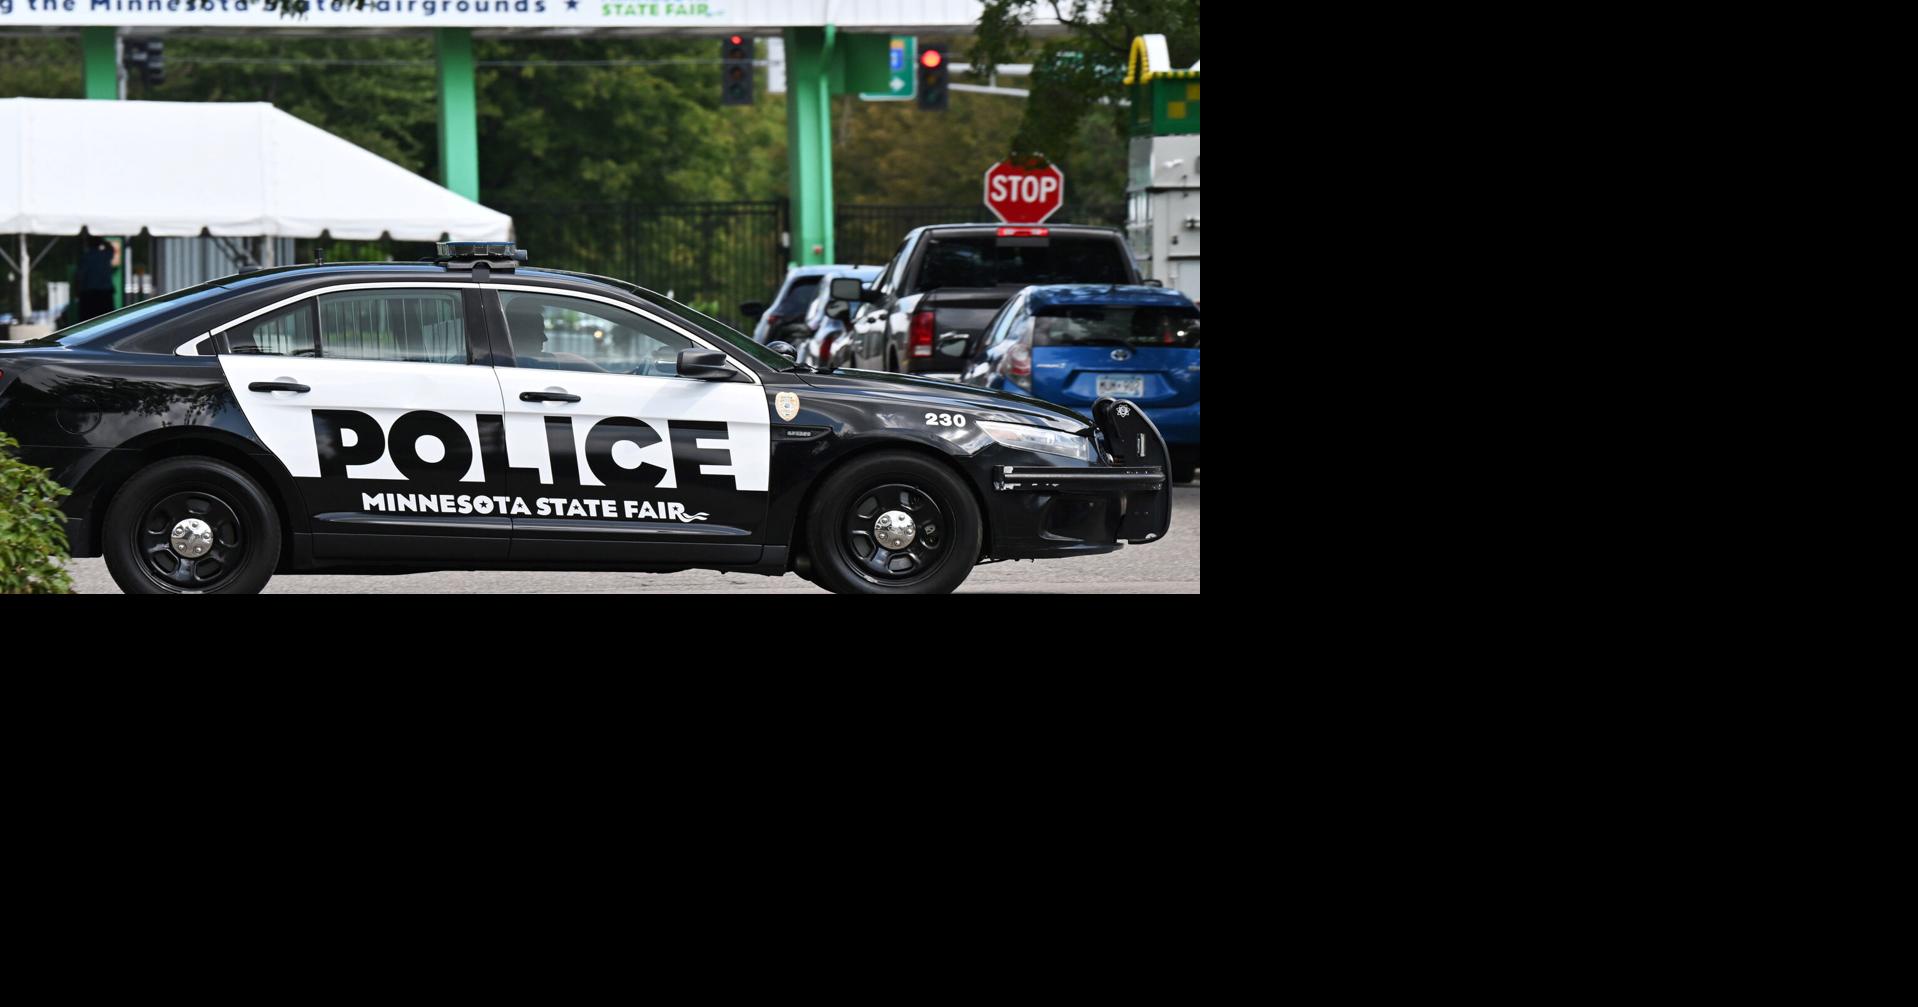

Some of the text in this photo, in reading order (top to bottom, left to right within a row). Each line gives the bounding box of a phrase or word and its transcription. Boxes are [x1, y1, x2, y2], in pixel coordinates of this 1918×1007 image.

[27, 0, 76, 11] the
[90, 0, 248, 11] Minnesota
[602, 3, 709, 16] STATE FAIR
[991, 174, 1058, 203] STOP
[925, 412, 966, 428] 230
[312, 408, 738, 491] POLICE
[361, 492, 692, 522] MINNESOTA STATE FAIR
